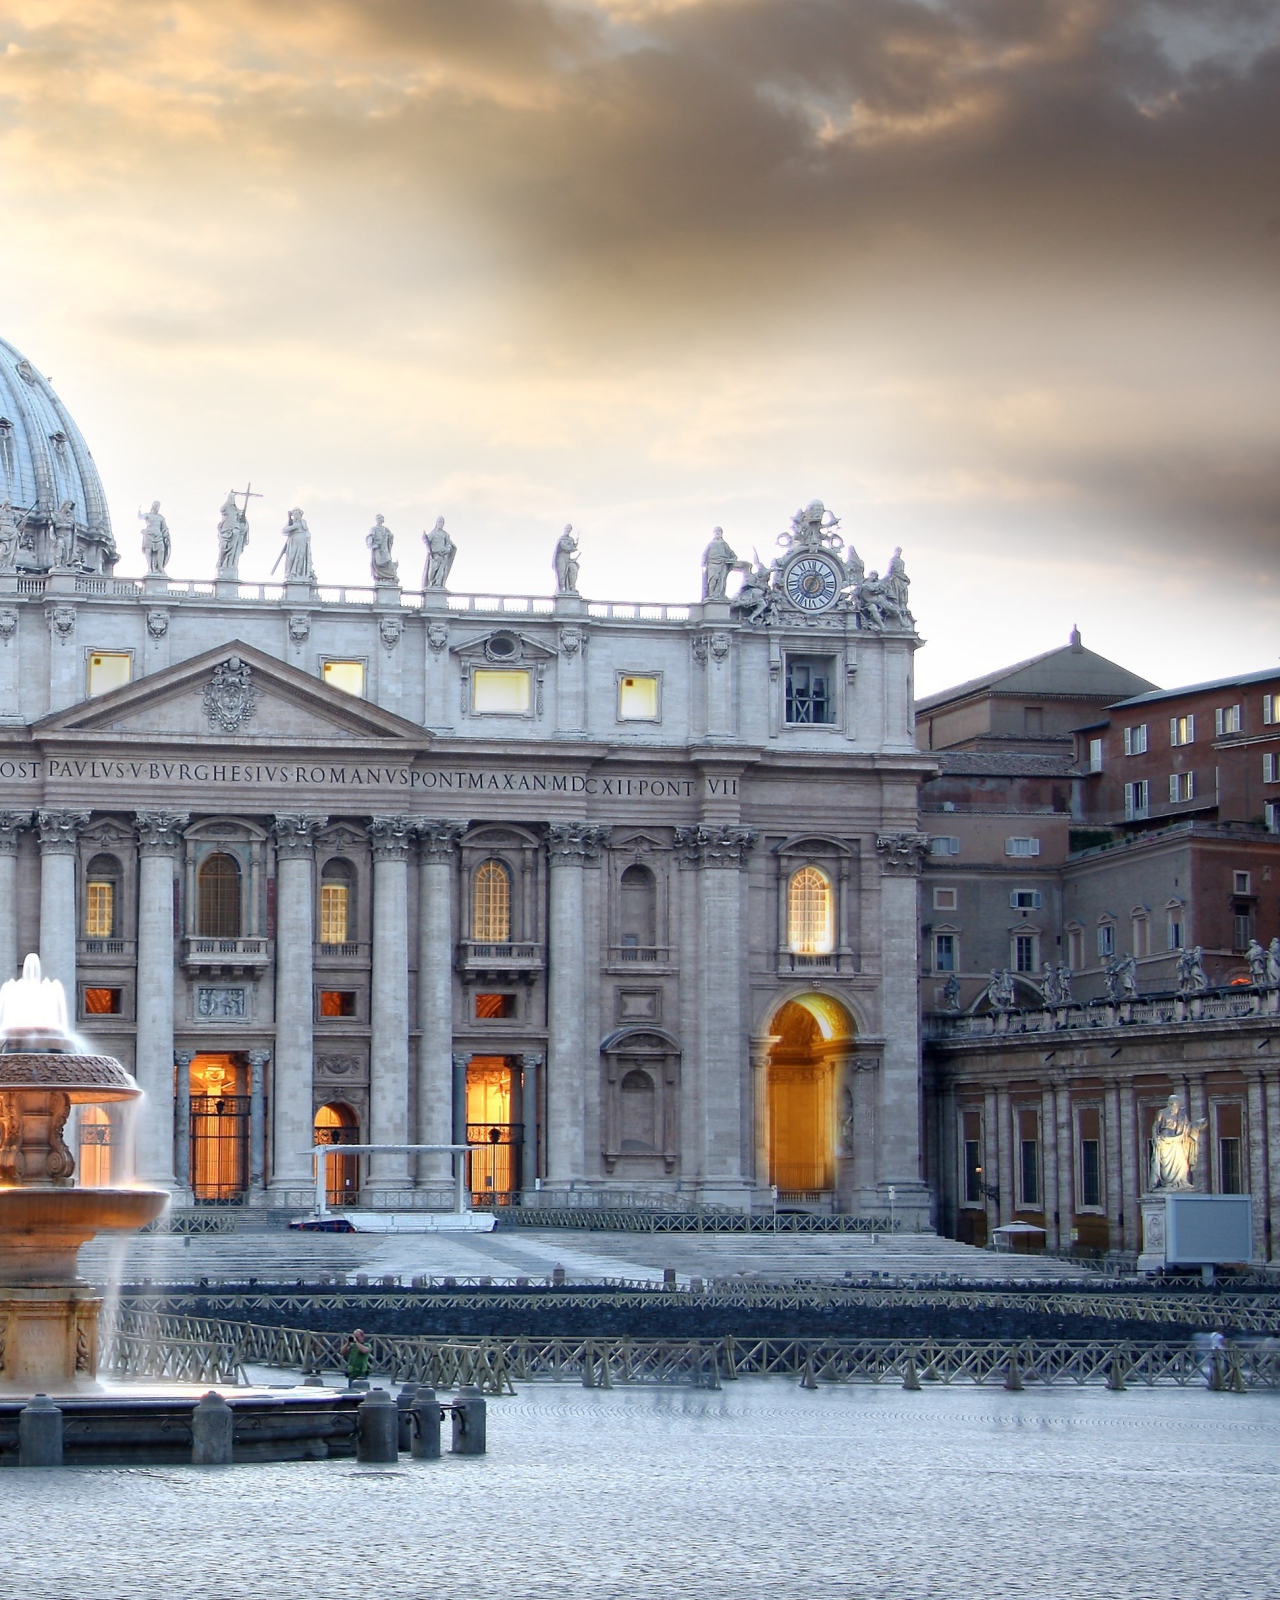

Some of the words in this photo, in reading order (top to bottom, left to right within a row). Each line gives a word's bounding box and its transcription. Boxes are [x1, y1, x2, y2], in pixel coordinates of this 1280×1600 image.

[49, 760, 124, 779] PAVLVS
[149, 763, 288, 783] BVRGHESIVS
[296, 766, 408, 785] ROMANVS
[410, 771, 466, 788] PONT
[468, 773, 514, 790] MAX
[552, 774, 631, 795] MDCXII
[639, 779, 694, 797] PONT
[708, 779, 737, 796] VII
